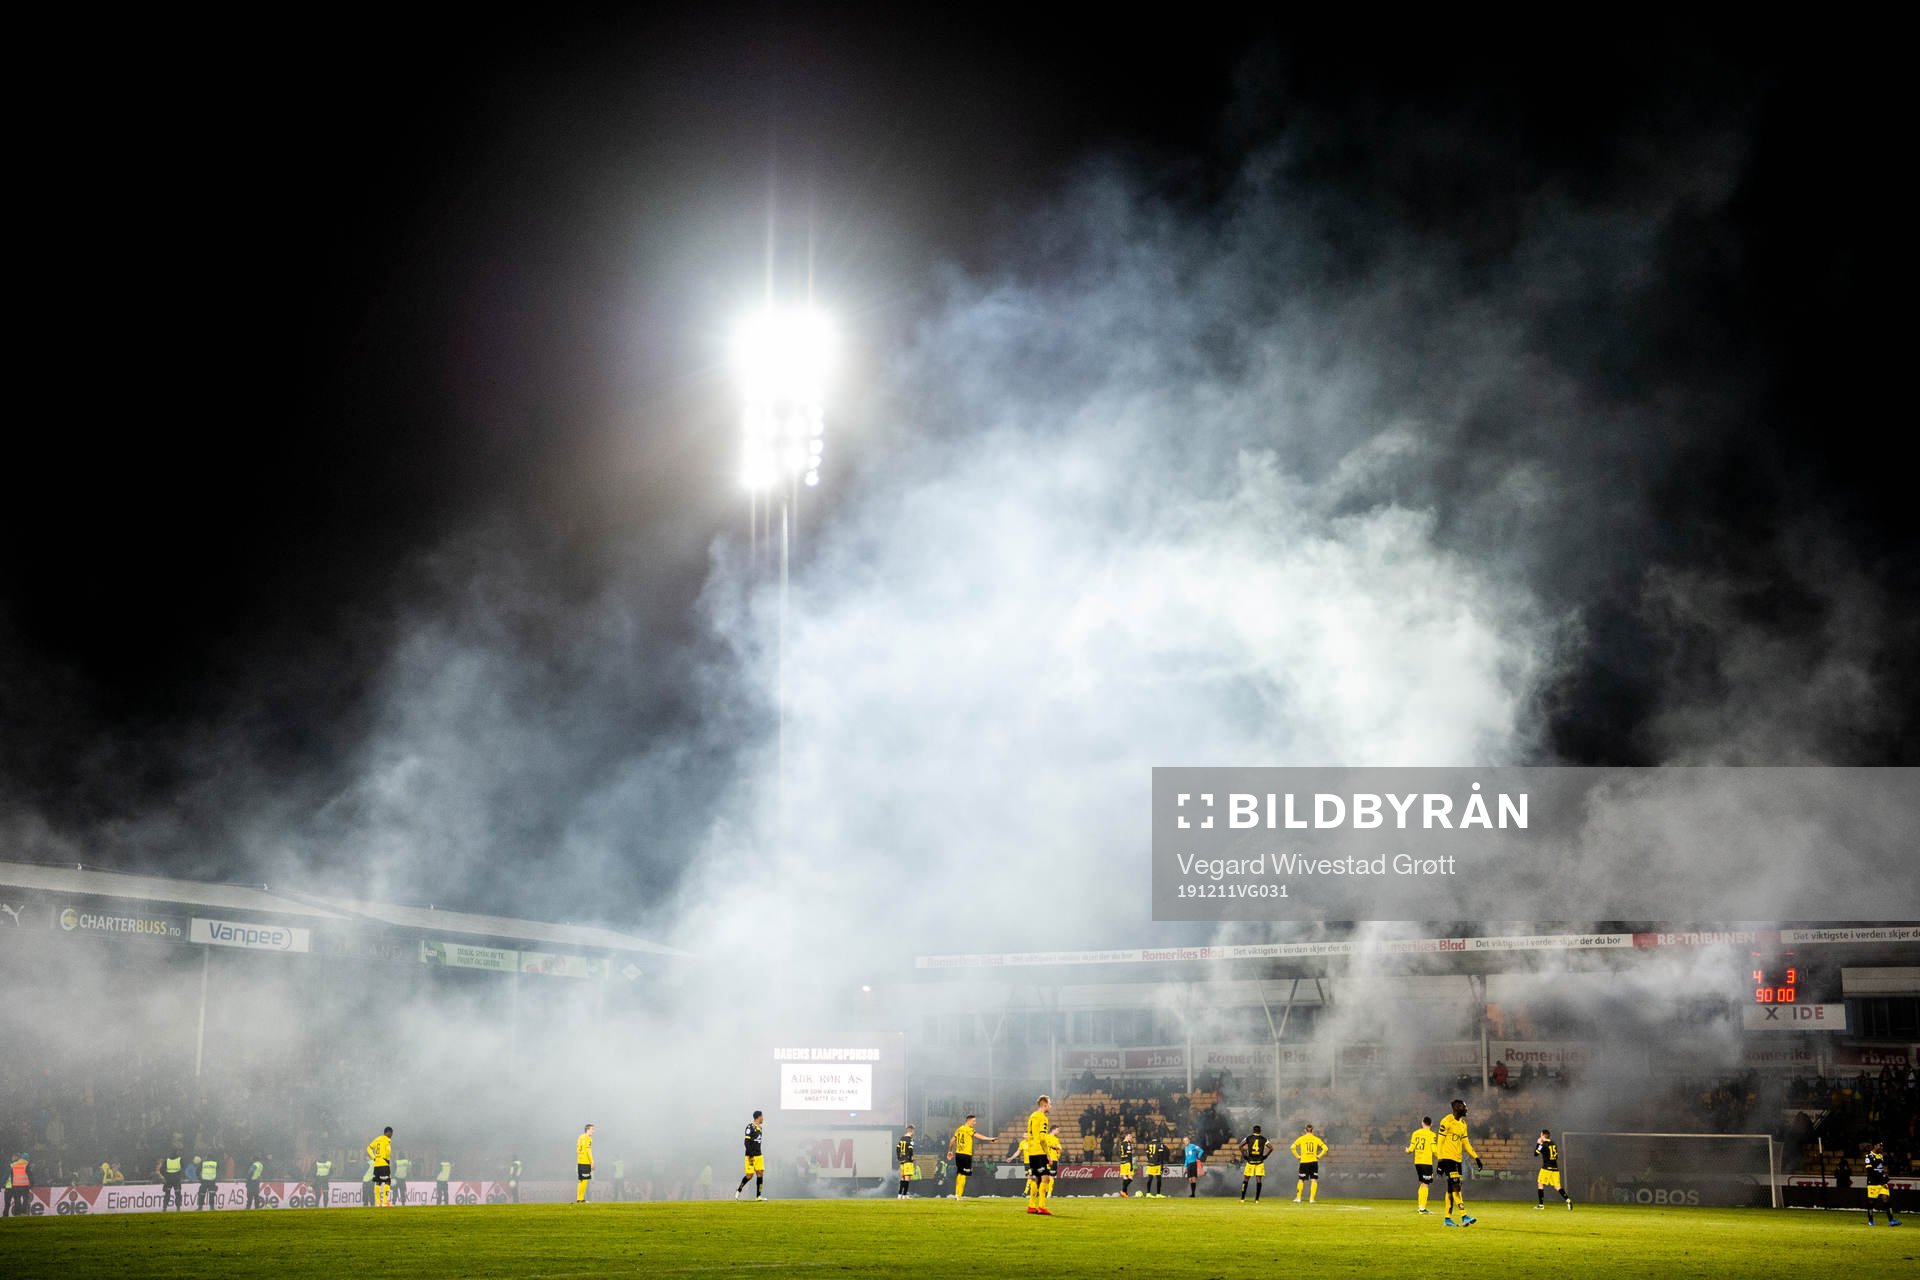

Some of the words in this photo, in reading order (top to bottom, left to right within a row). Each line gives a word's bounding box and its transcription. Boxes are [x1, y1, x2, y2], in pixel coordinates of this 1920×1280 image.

[209, 922, 284, 945] Vanpee
[1440, 939, 1466, 951] Blad
[1595, 936, 1605, 944] du
[1752, 969, 1762, 984] 4
[1786, 969, 1796, 984] 3
[1755, 988, 1773, 1003] 90
[1777, 987, 1796, 1003] 00
[1252, 1139, 1260, 1152] 4
[1415, 1136, 1426, 1151] 23
[228, 1189, 244, 1206] AS
[1636, 1188, 1699, 1206] OBOS
